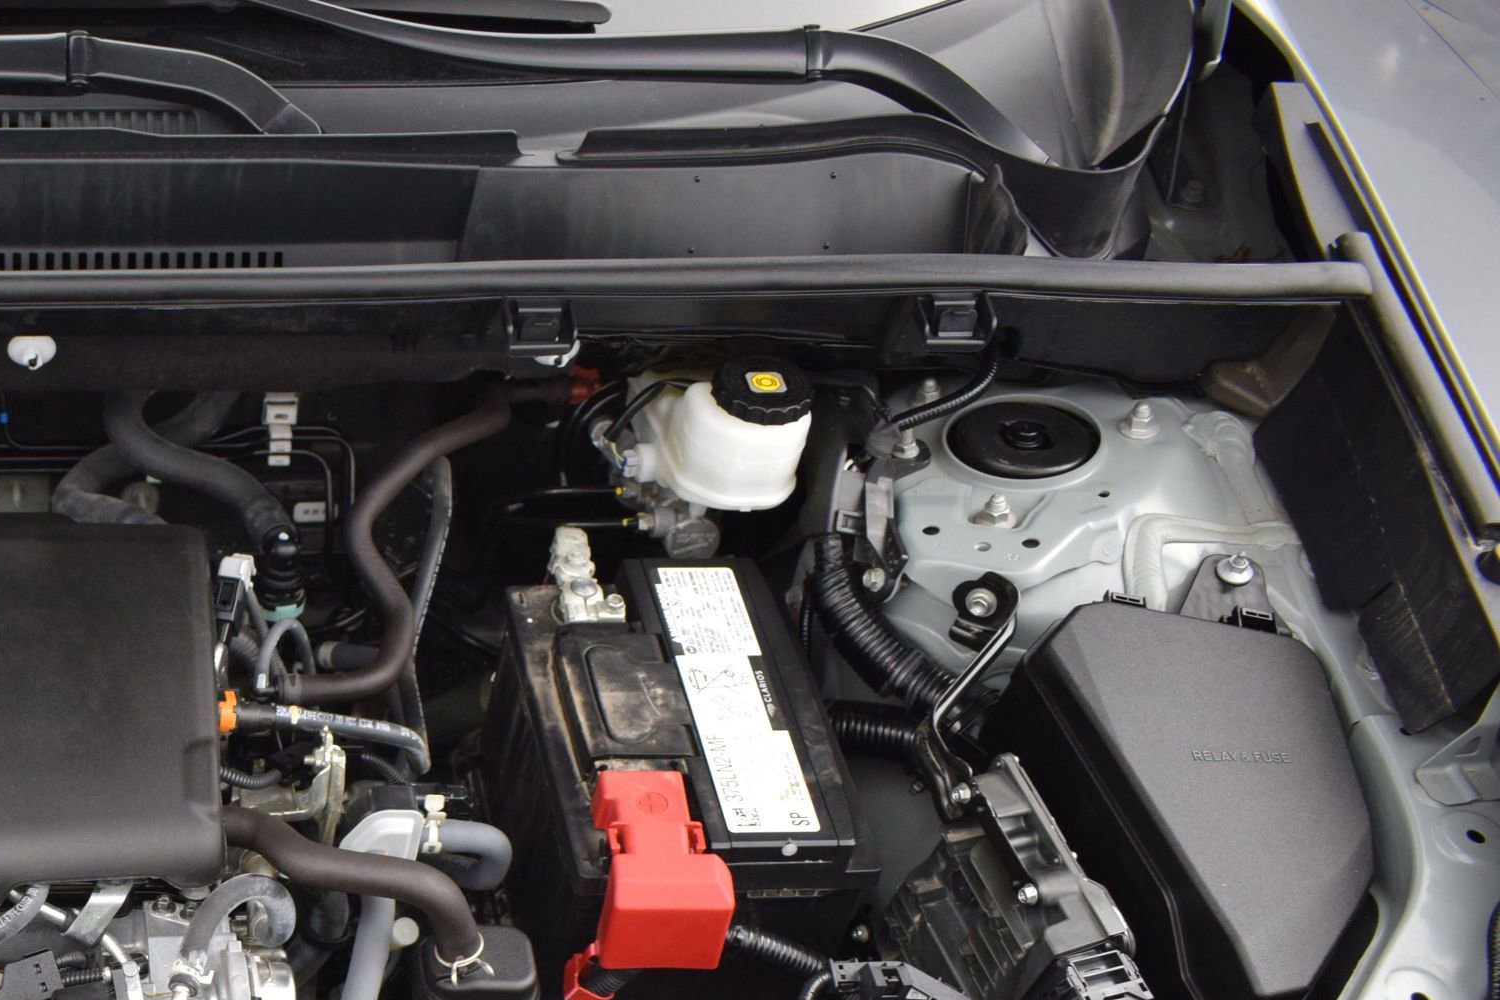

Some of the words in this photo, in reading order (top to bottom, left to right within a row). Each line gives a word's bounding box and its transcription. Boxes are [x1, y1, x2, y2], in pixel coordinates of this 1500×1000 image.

[754, 669, 773, 703] CLARIOS
[1191, 749, 1238, 762] RELAY
[1241, 751, 1250, 762] &
[1253, 751, 1292, 763] FUSE
[789, 811, 810, 826] SP
